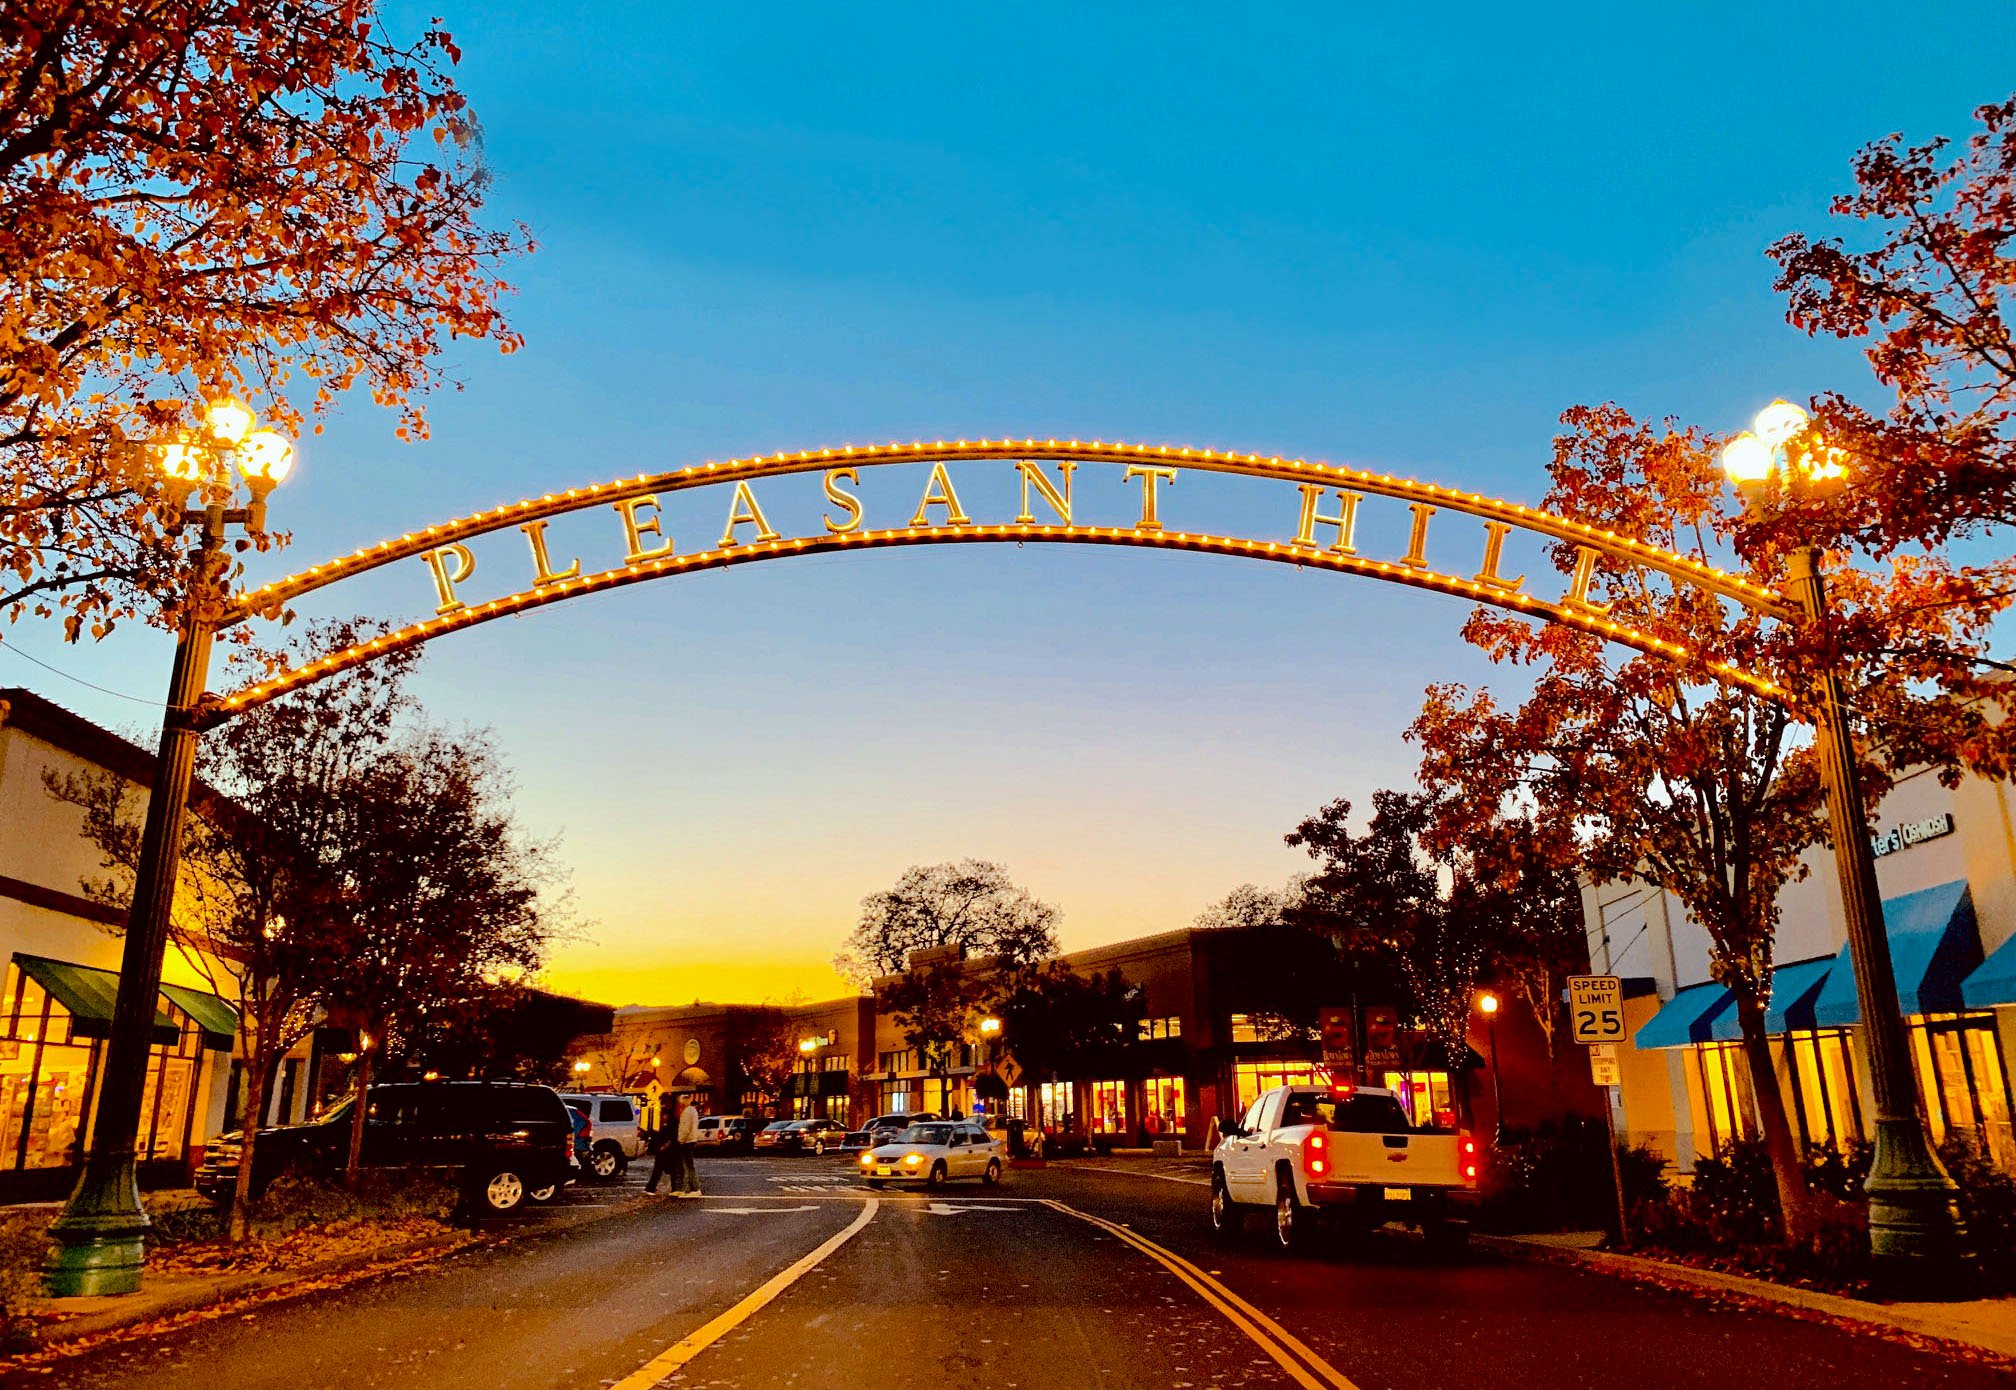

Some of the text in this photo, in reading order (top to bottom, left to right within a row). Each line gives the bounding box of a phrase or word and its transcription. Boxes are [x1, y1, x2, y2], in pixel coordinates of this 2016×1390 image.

[421, 460, 1614, 617] PLEASANT HILL
[1871, 833, 1900, 856] ter's
[1573, 980, 1617, 991] SPEED
[1579, 994, 1613, 1005] LIMIT
[1577, 1010, 1621, 1035] 25
